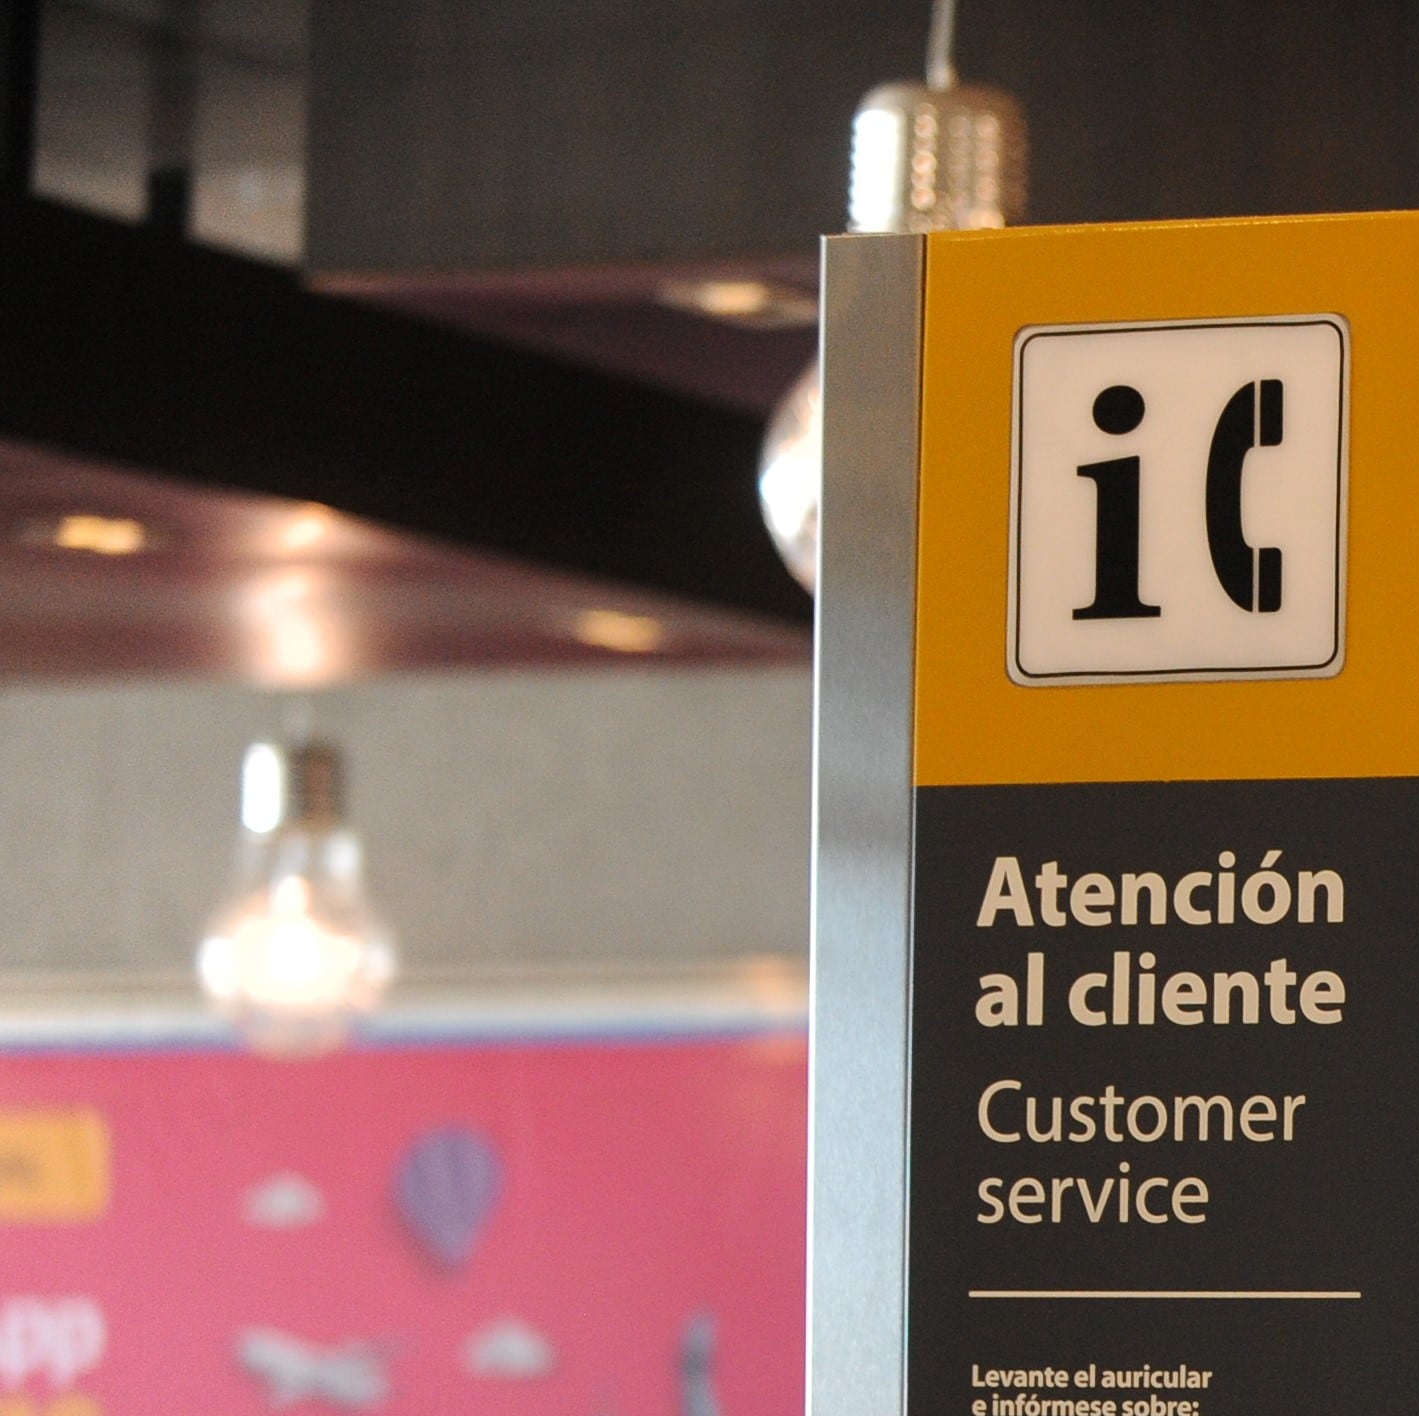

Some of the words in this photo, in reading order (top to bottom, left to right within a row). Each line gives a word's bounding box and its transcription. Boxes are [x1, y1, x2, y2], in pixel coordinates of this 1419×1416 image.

[977, 850, 1344, 927] Atención
[975, 952, 1044, 1027] al
[1069, 951, 1345, 1026] cliente
[979, 1080, 1305, 1142] Customer
[977, 1162, 1208, 1223] service
[972, 1365, 1069, 1388] Levante
[1074, 1364, 1096, 1387] el
[1101, 1364, 1212, 1388] auricular
[972, 1400, 987, 1416] e
[992, 1393, 1116, 1416] infórmese
